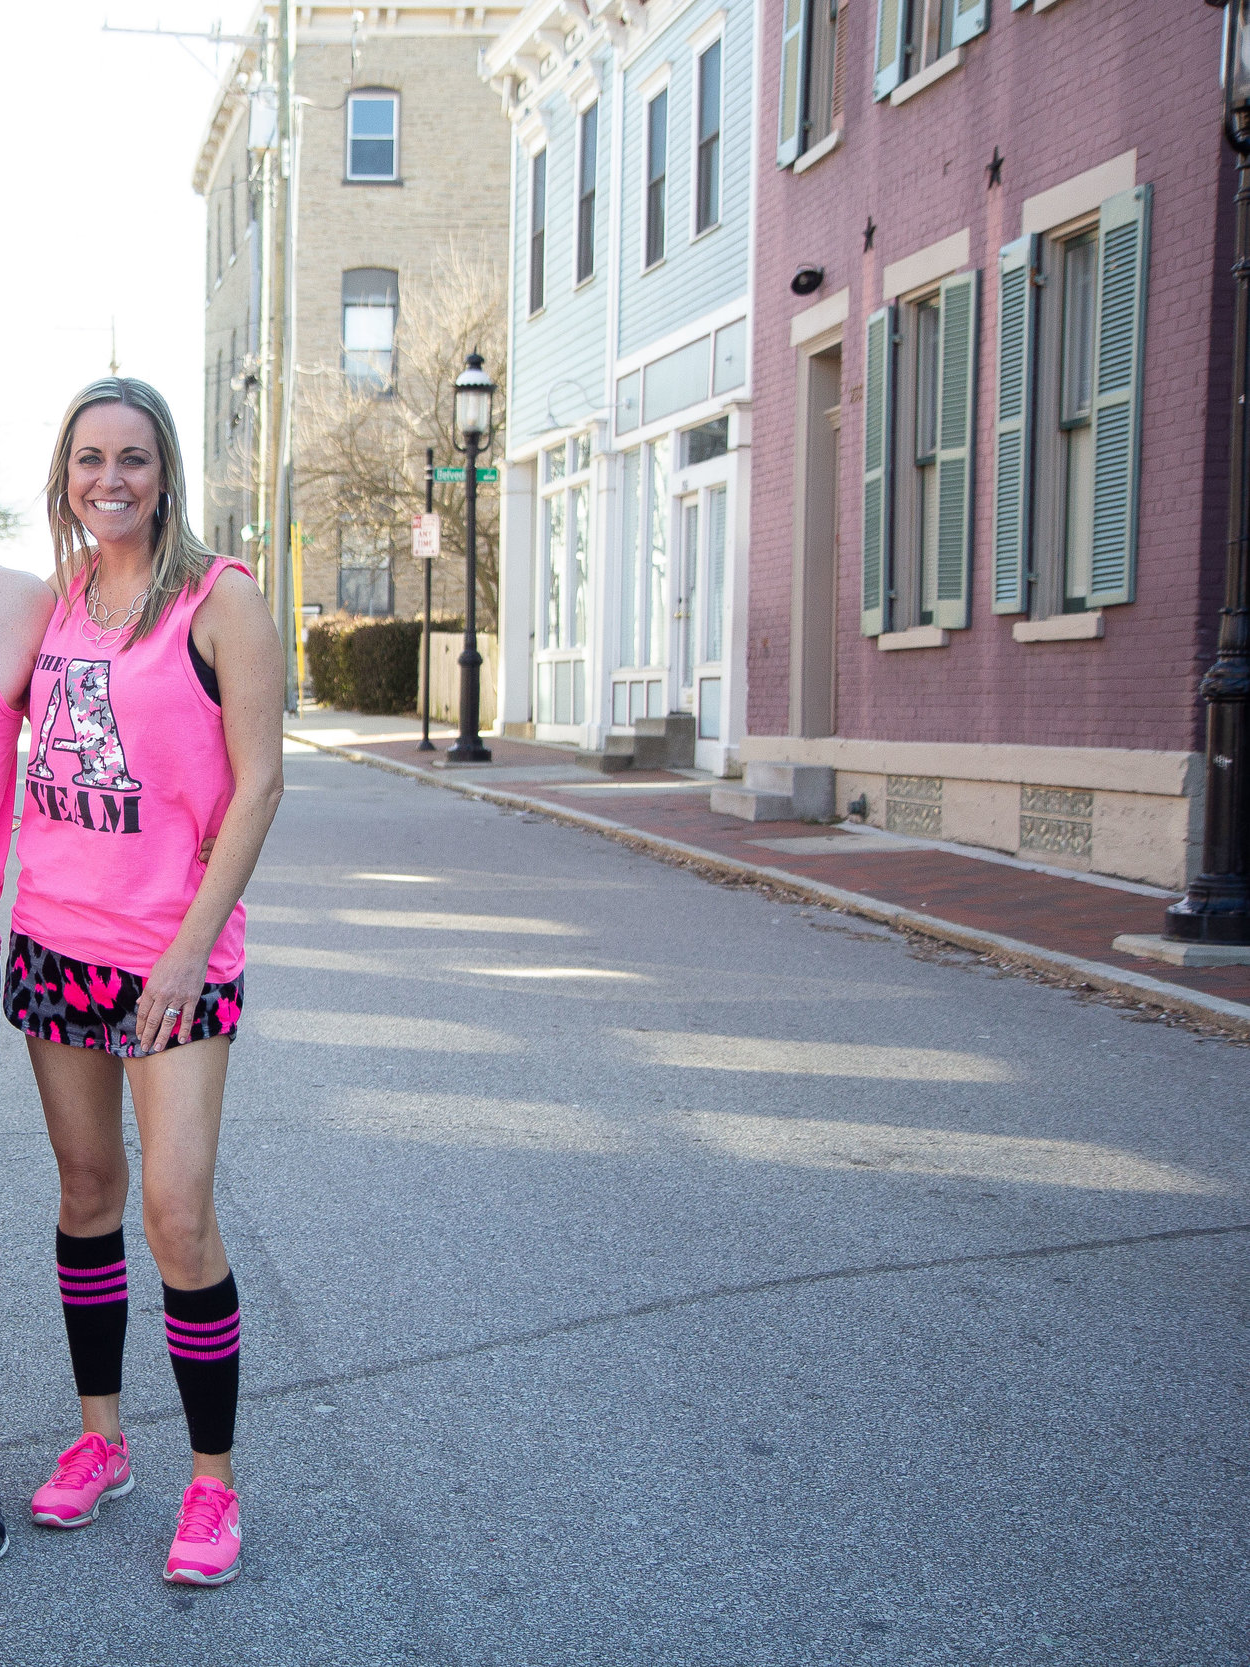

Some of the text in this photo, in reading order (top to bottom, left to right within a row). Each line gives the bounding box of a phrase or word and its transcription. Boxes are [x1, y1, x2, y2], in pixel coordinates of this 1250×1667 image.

[437, 468, 466, 480] Belved
[36, 653, 66, 673] THE
[27, 658, 143, 793] A
[26, 778, 143, 834] TEAM
